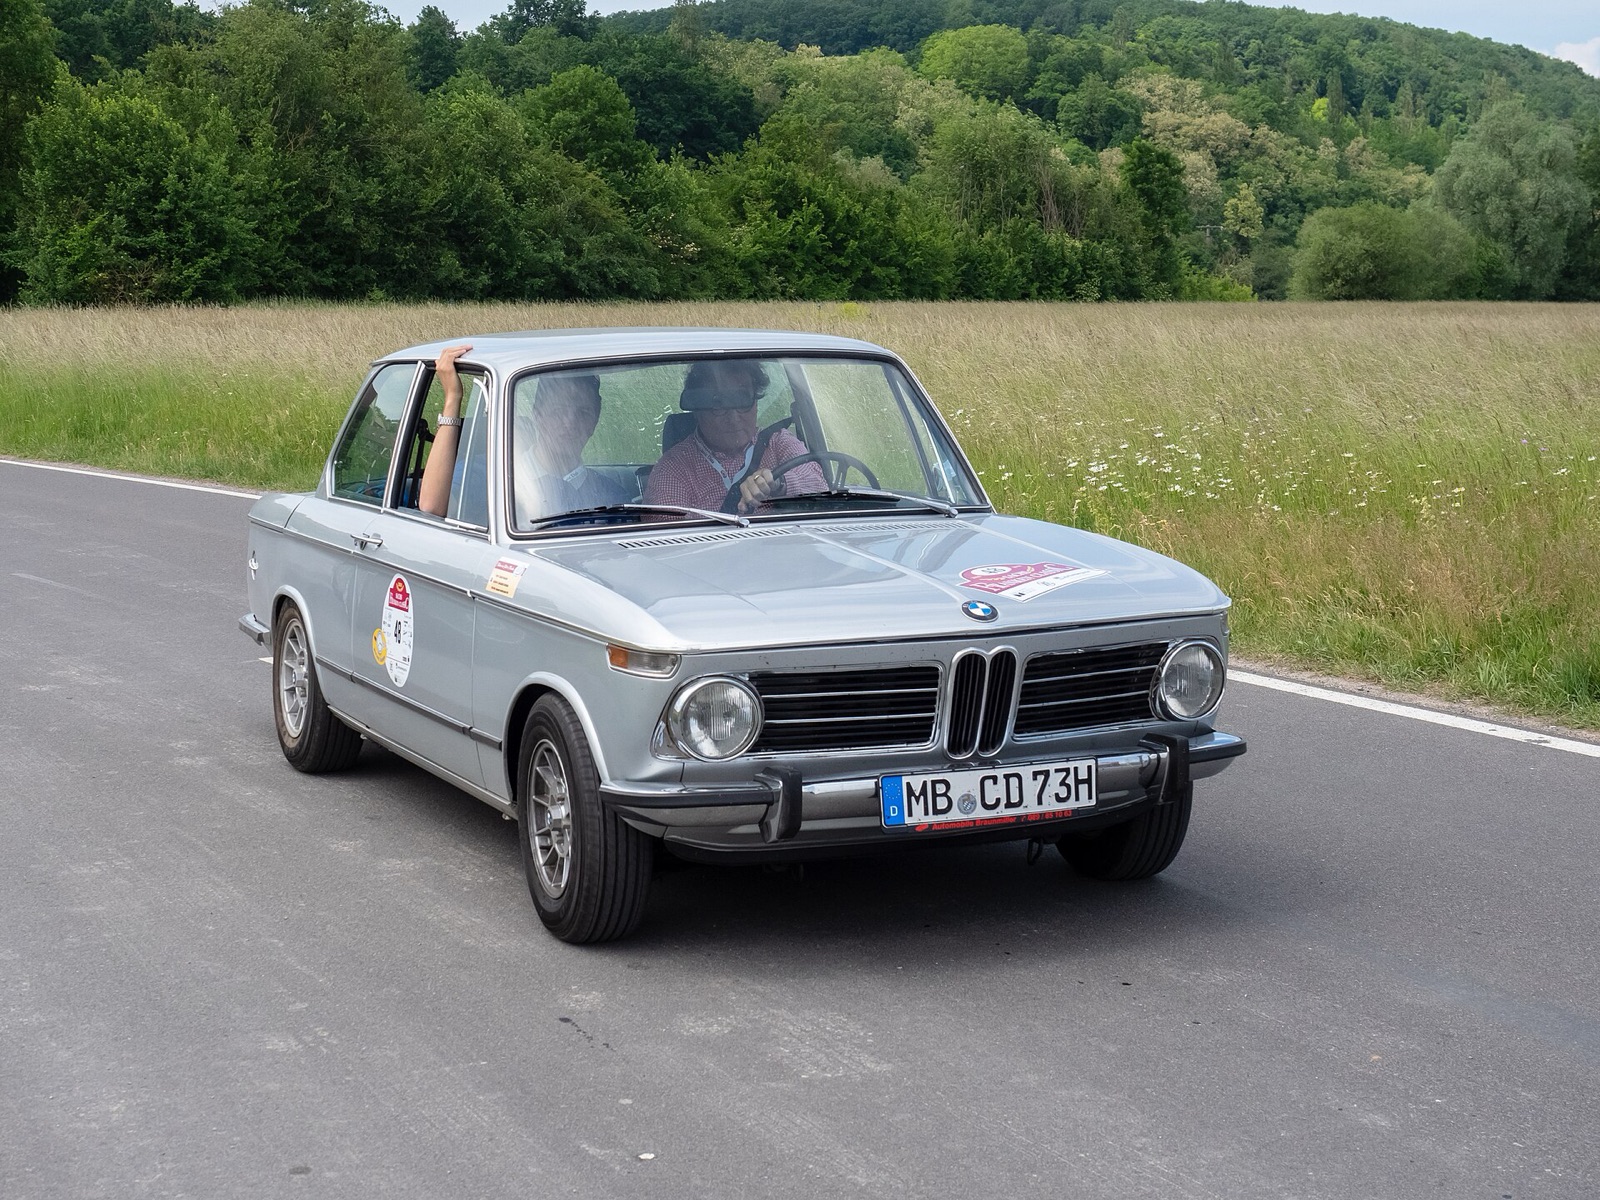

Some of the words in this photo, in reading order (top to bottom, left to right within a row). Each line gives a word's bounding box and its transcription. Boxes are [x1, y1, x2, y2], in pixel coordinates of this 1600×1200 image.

[905, 778, 953, 818] MB
[979, 772, 1024, 811] CD
[1032, 765, 1093, 806] 73H
[889, 806, 898, 817] D
[932, 819, 974, 831] Automobile
